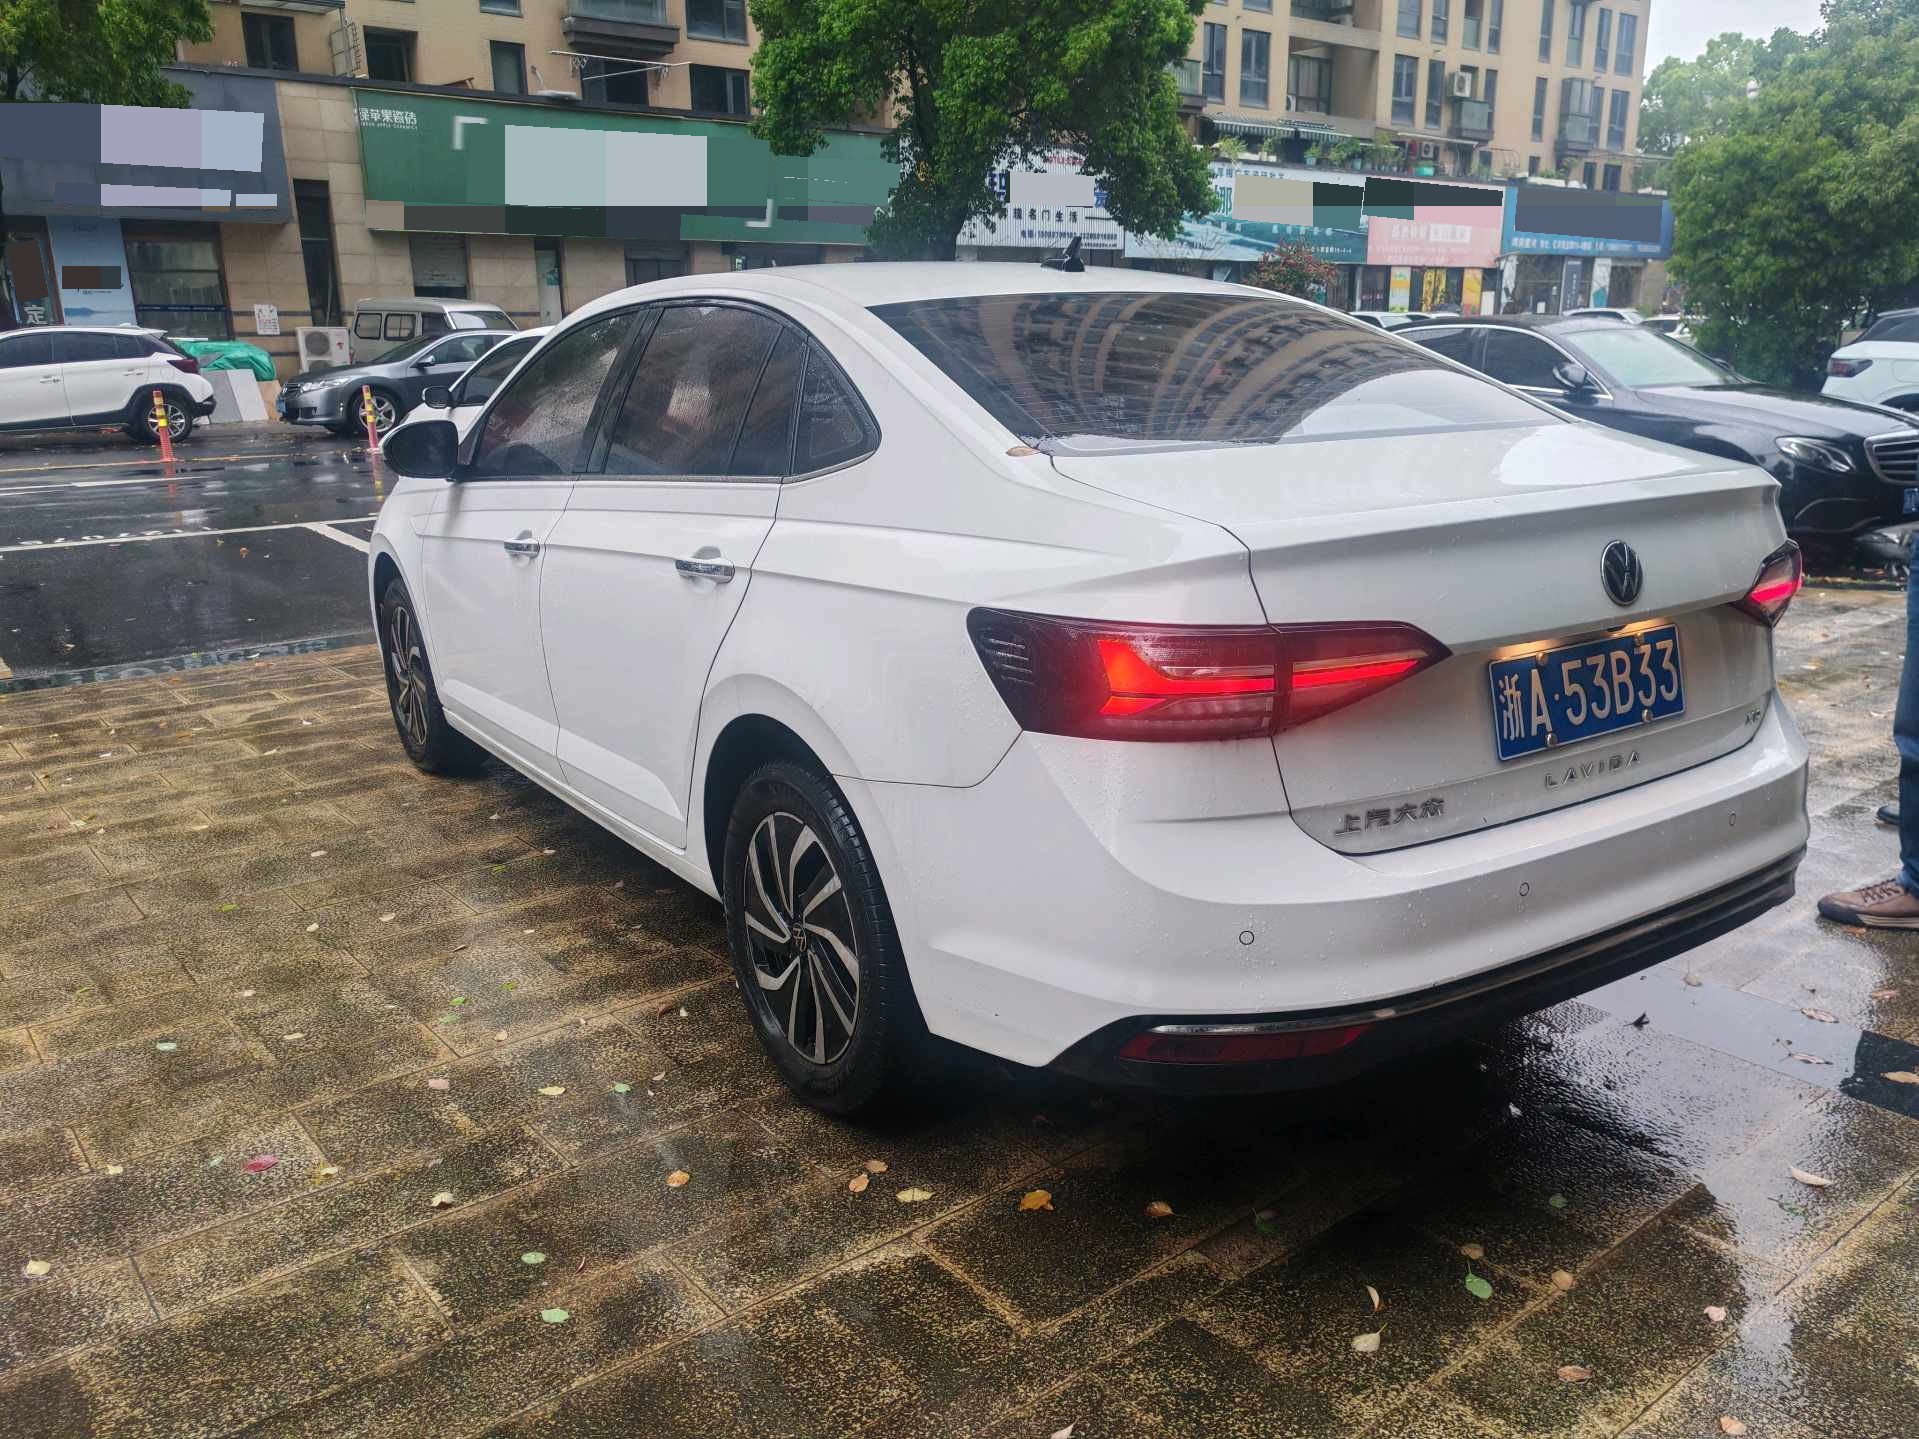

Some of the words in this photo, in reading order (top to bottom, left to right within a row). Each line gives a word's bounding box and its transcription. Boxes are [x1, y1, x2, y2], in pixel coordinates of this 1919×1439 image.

[1544, 750, 1641, 789] LAVIDA
[1334, 798, 1445, 836] 上汽大众
